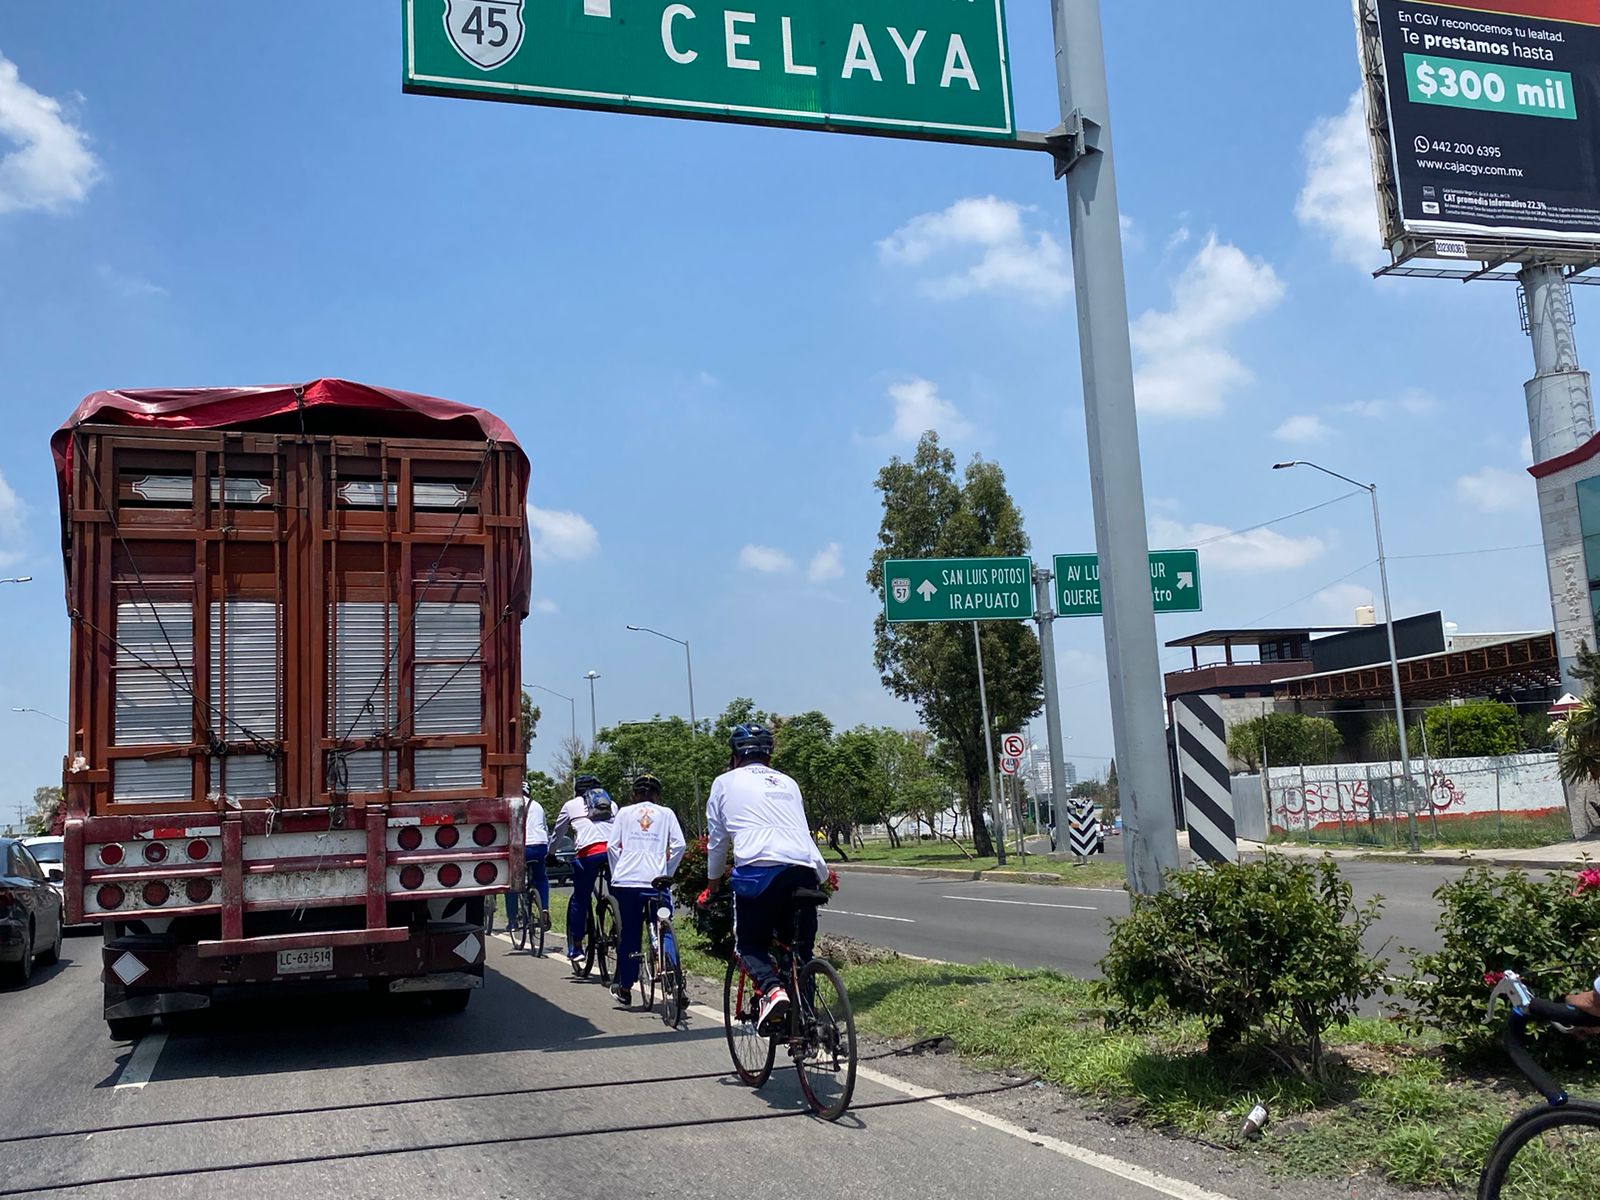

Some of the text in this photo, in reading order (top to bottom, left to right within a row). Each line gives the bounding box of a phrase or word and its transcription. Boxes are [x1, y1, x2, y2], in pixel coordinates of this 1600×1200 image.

[462, 6, 508, 47] 45
[1398, 11, 1566, 43] En CGV reconocemos tu lealtad.
[661, 3, 980, 91] CELAYA
[1400, 27, 1554, 61] Te prestamos hasta
[1416, 60, 1566, 109] $300 mil
[1432, 140, 1501, 158] 442 200 6395
[1416, 159, 1524, 177] www.cajacgv.com.mx
[1443, 193, 1456, 203] CAT
[1457, 196, 1488, 207] promedio
[942, 567, 1025, 586] SAN LUIS POTOSI
[1067, 565, 1081, 581] AV
[1085, 565, 1100, 581] LU
[896, 588, 907, 599] 57
[950, 592, 1020, 610] IRAPUATO
[1063, 586, 1172, 606] QUERE tro
